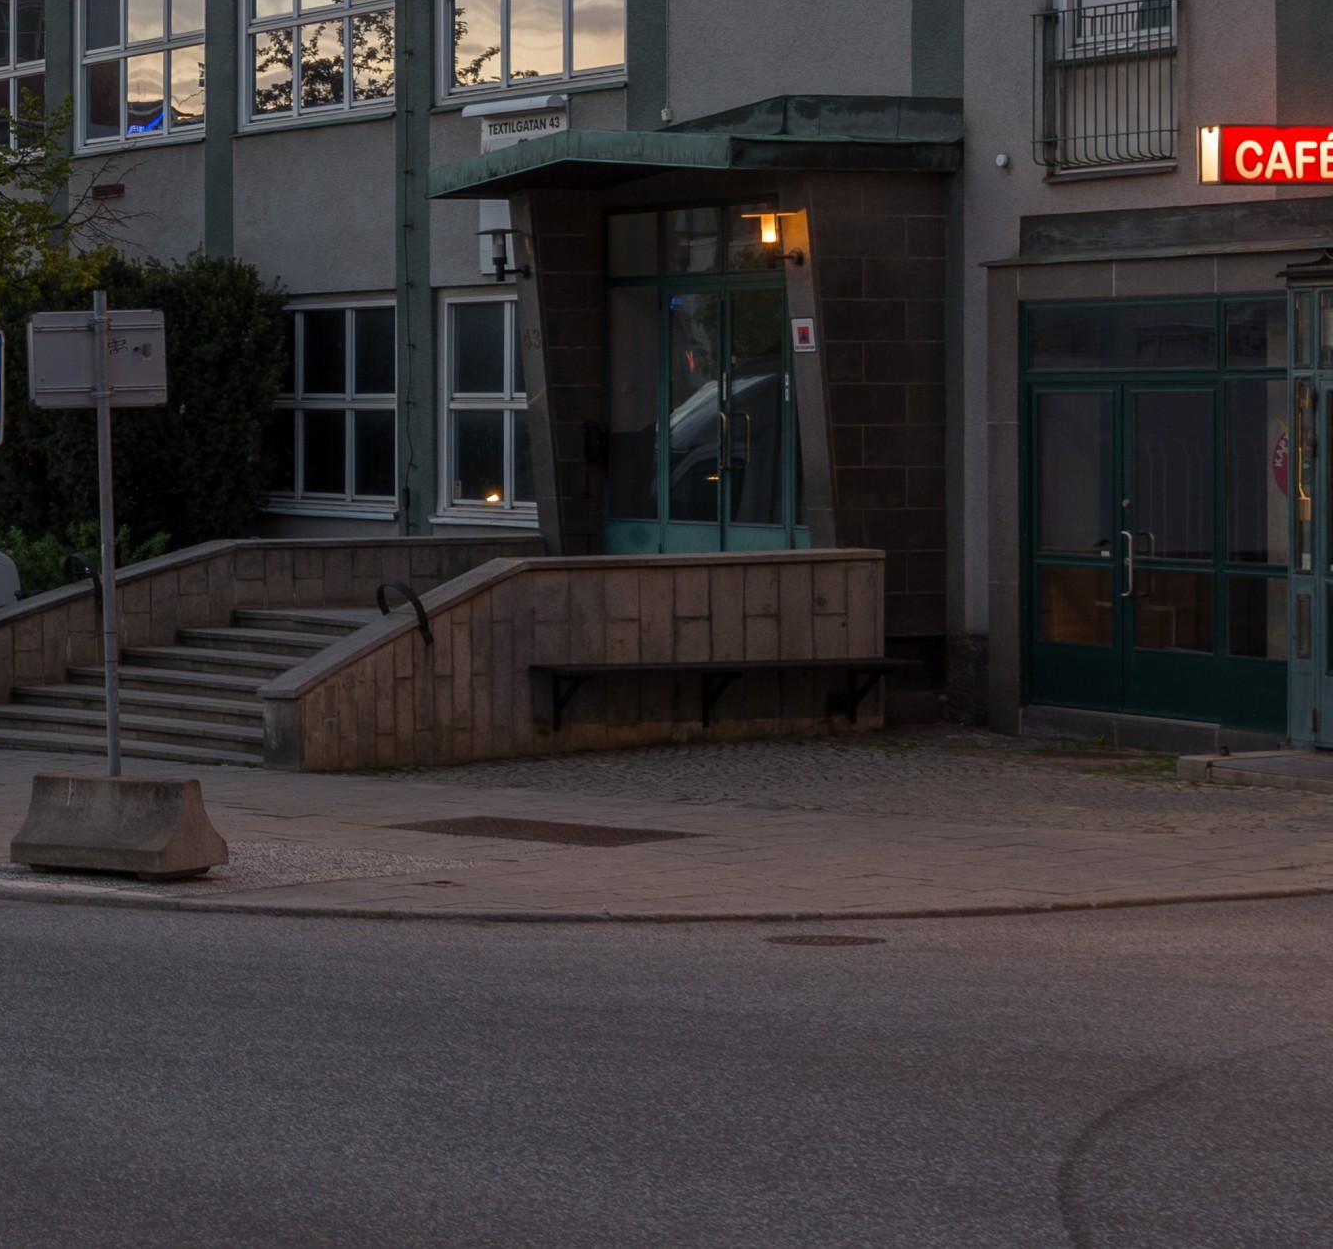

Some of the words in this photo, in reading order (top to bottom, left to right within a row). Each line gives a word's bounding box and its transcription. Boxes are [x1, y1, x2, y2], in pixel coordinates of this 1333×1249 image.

[488, 117, 547, 136] TEXTILGATAN
[548, 116, 560, 129] 43
[1235, 131, 1333, 180] CAFÉ
